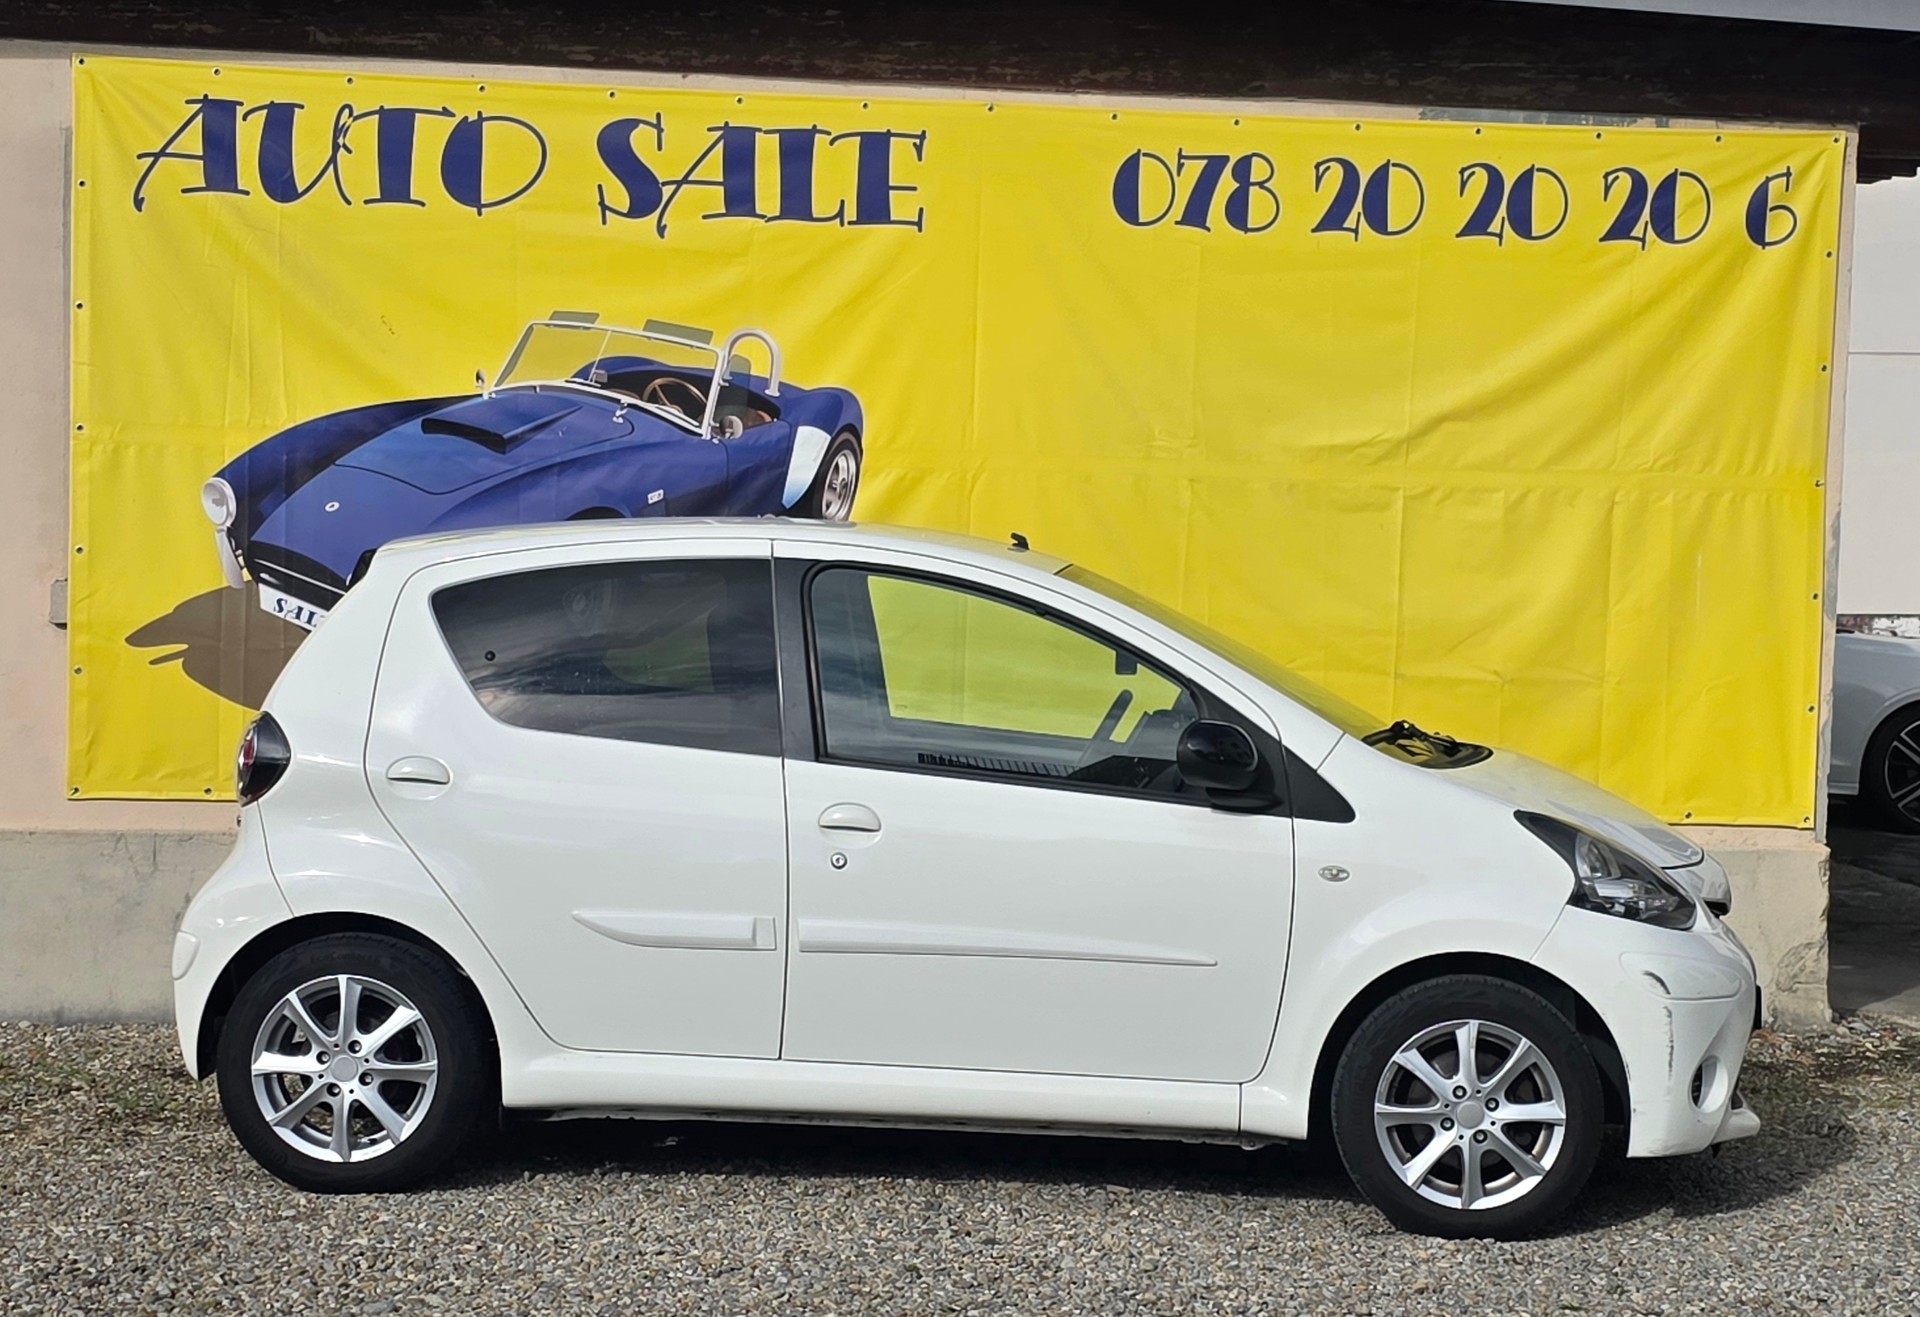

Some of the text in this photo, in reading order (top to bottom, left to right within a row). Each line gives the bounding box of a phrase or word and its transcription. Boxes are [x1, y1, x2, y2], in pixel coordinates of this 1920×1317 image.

[133, 94, 927, 238] AUTO SALE
[1112, 148, 1798, 250] 078 20 20 20 6
[273, 598, 325, 629] SAL
